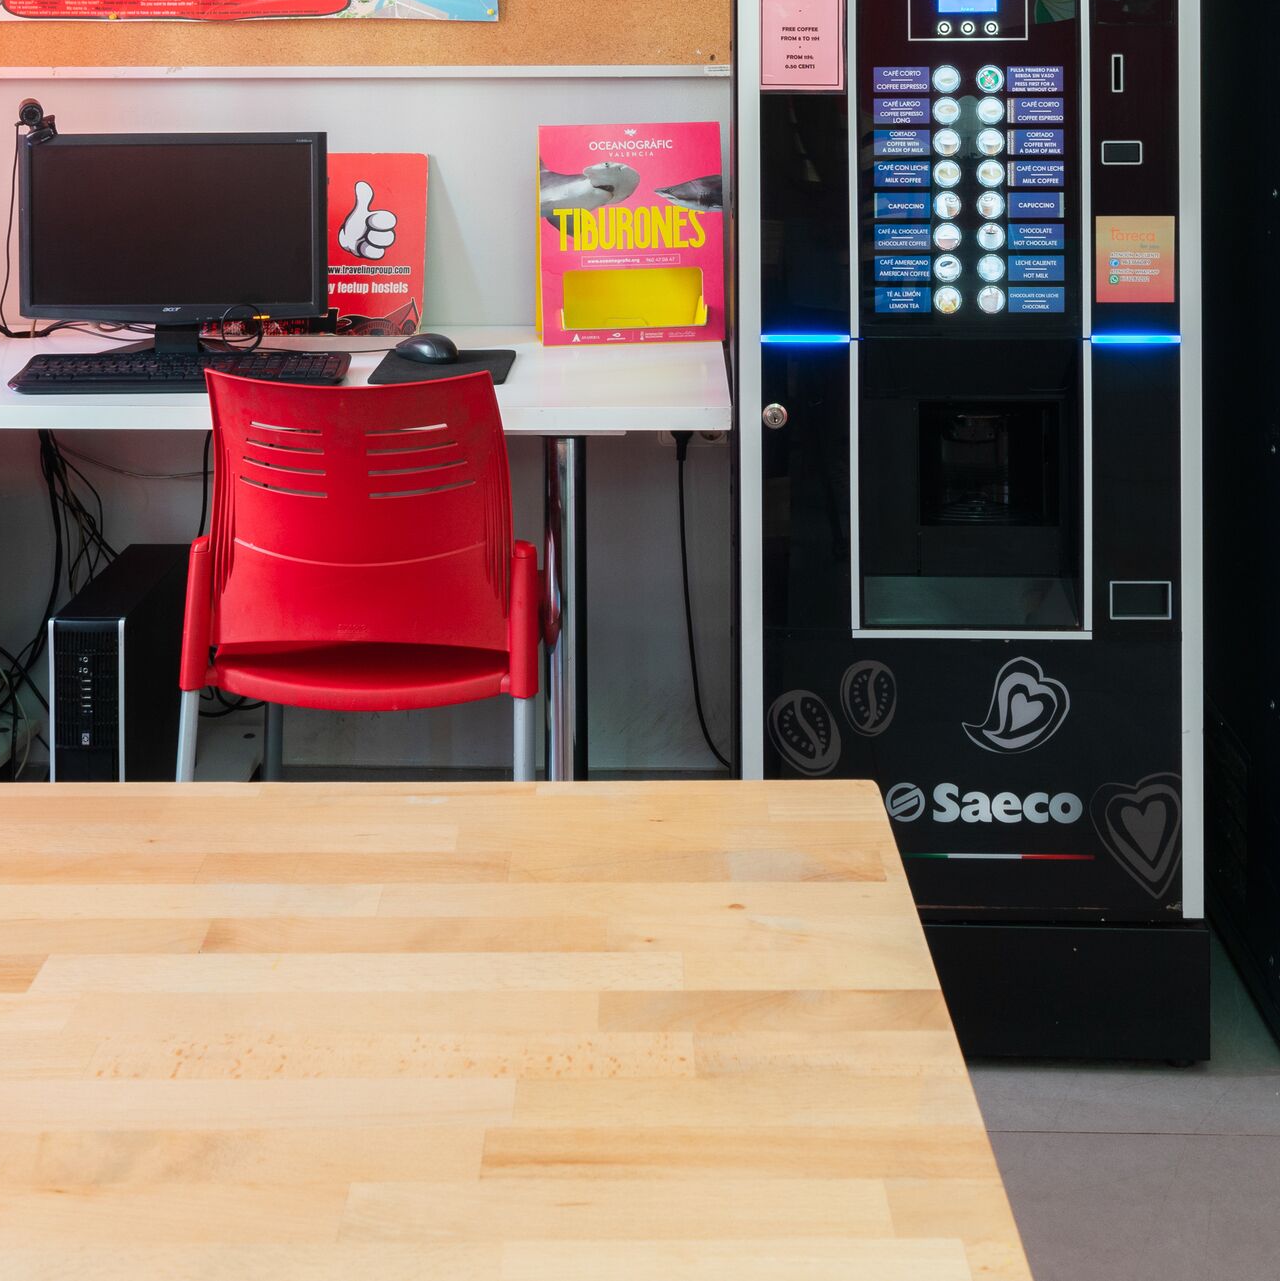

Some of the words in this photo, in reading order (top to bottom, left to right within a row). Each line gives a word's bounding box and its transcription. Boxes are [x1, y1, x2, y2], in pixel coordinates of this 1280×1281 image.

[589, 139, 673, 151] OCEANOGRÀFIC
[553, 206, 706, 252] TIBURONES
[328, 266, 410, 275] ww.travelingroup.com
[338, 282, 369, 294] feetup
[372, 282, 408, 294] hostels
[933, 782, 1083, 824] Saeco
